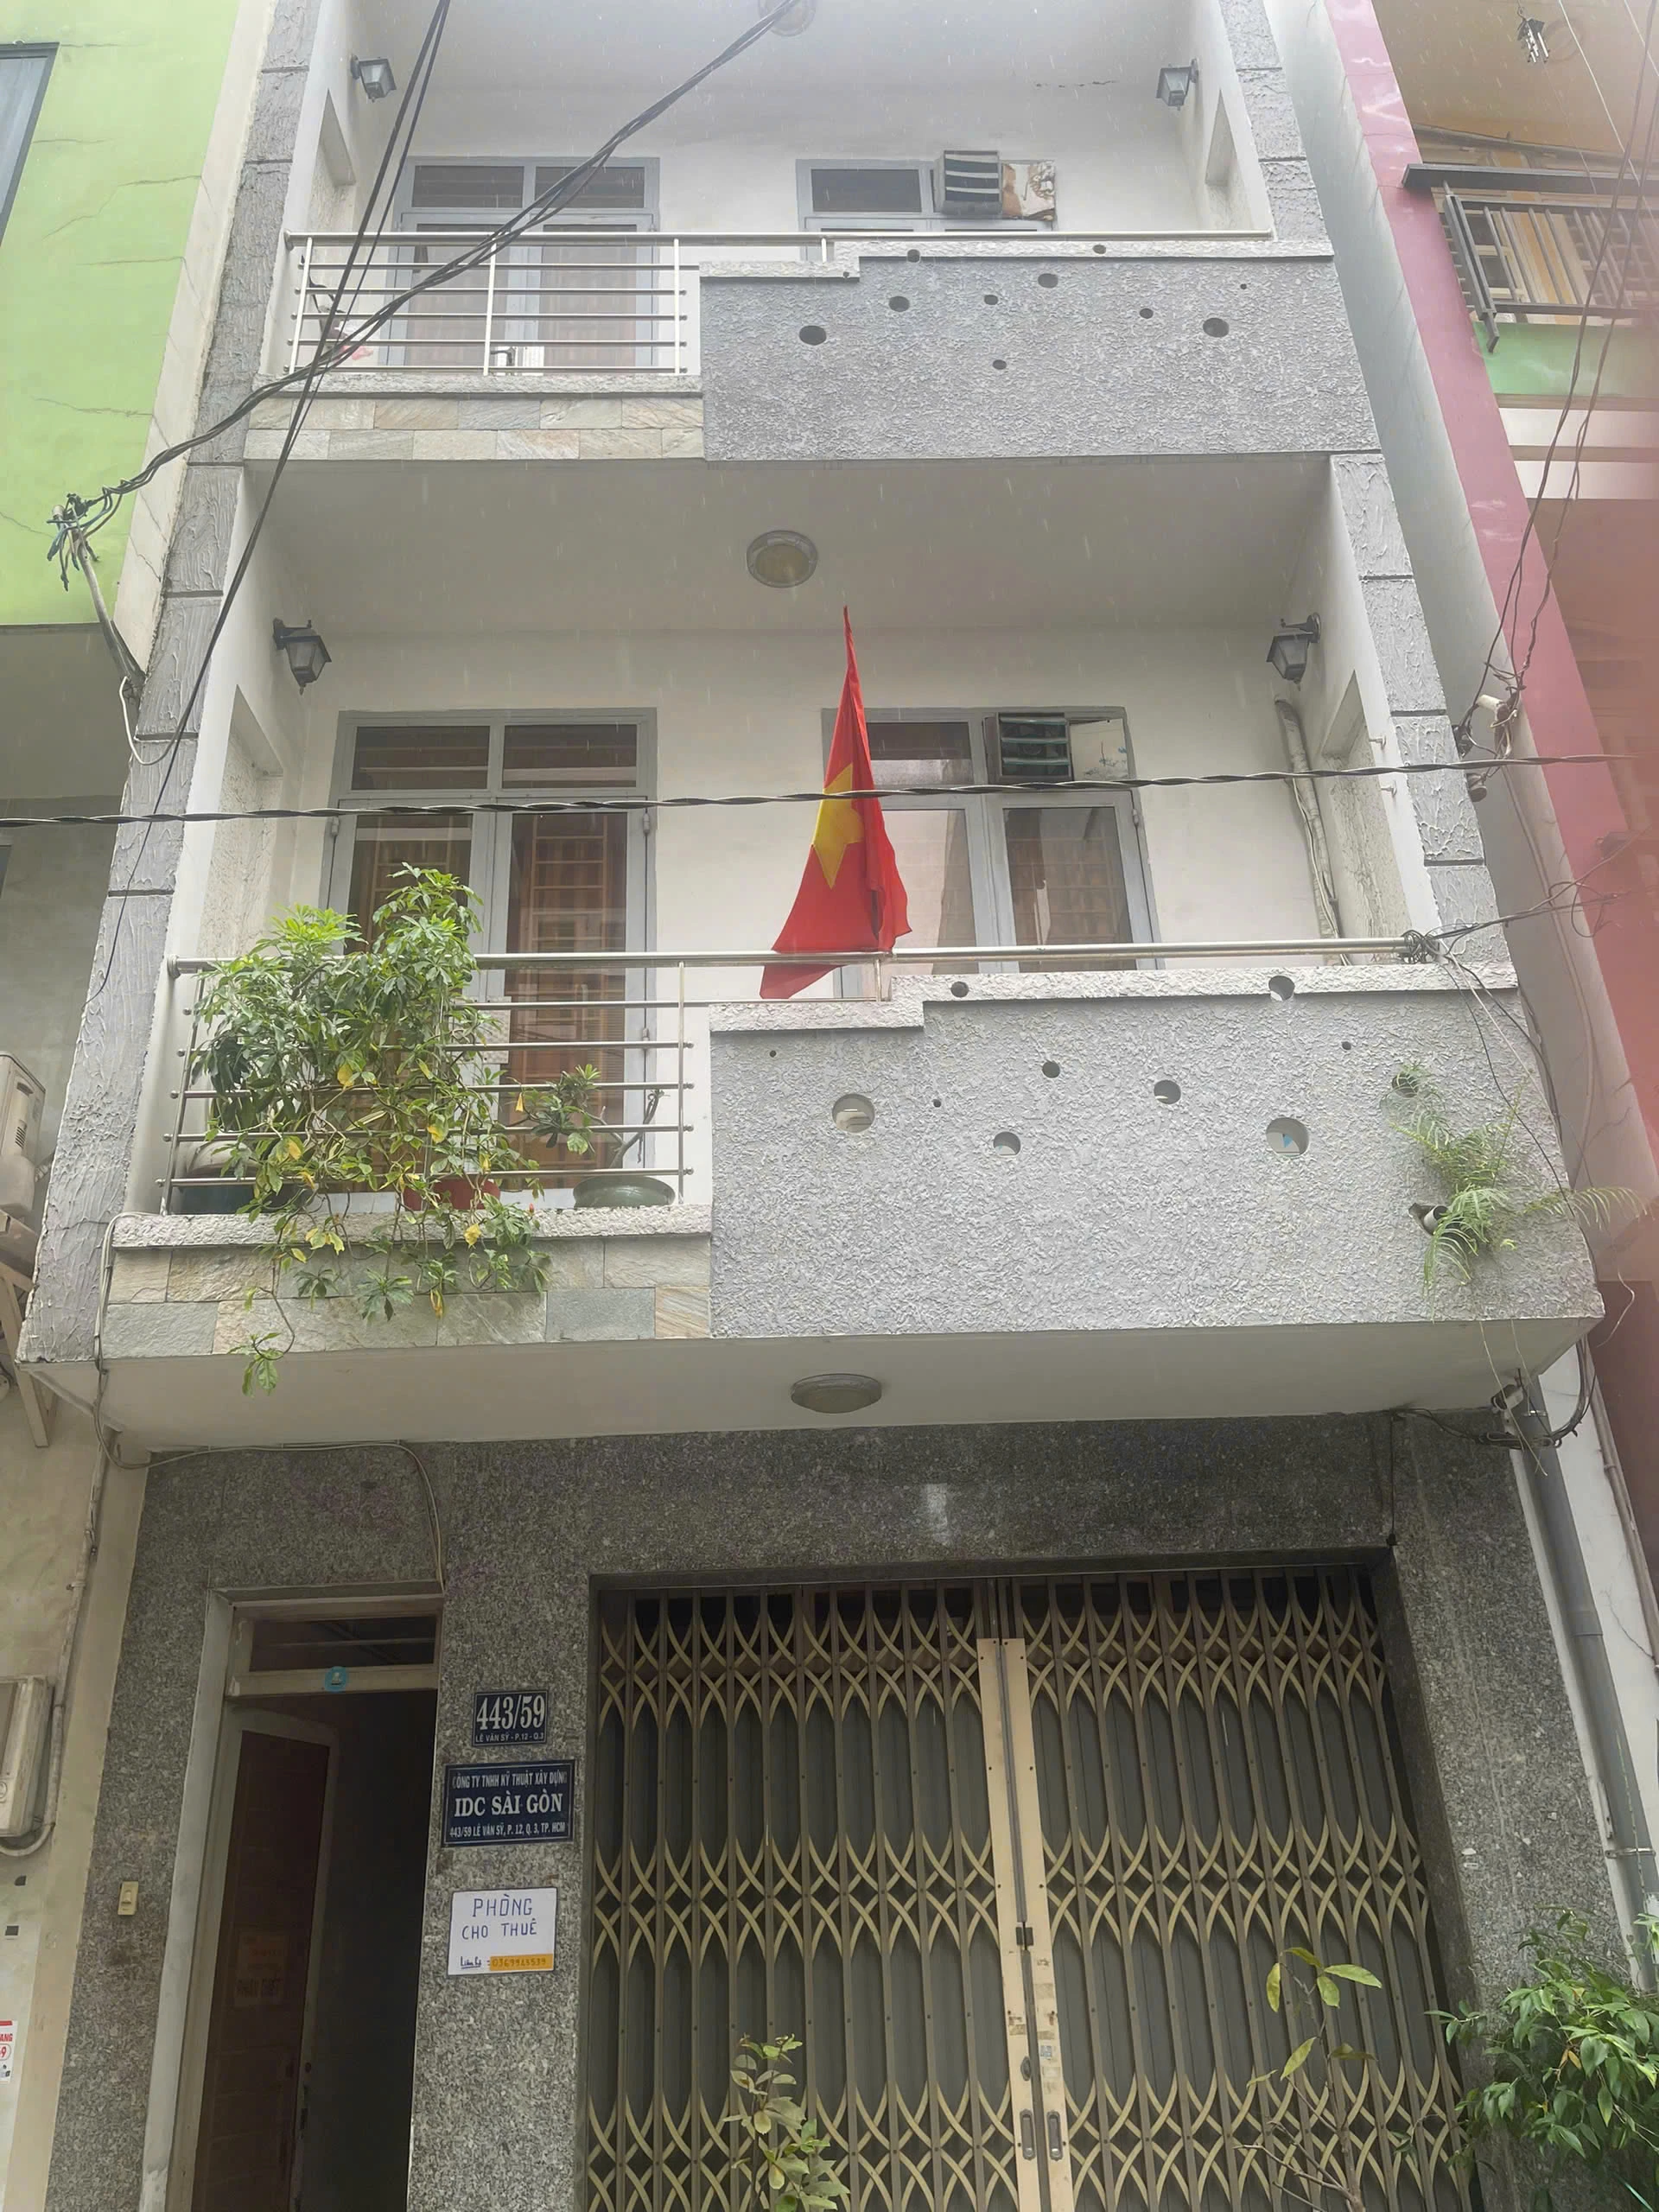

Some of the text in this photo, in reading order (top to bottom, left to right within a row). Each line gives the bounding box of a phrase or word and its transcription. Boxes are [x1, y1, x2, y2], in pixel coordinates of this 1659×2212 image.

[476, 1694, 545, 1730] 443/59
[475, 1732, 484, 1743] LÊ
[452, 1771, 471, 1789] CÔNG
[471, 1775, 480, 1788] TY
[481, 1774, 499, 1787] TNHH
[512, 1770, 533, 1788] THUẬT
[535, 1770, 548, 1785] XÂY
[454, 1788, 563, 1817] IDC SÀI GÒN
[449, 1826, 472, 1838] 443/59
[473, 1822, 480, 1837] LÊ
[541, 1822, 550, 1833] TP.
[552, 1821, 565, 1833] HCM
[473, 1894, 532, 1917] PHÒNG
[461, 1918, 537, 1940] CHO THUÊ
